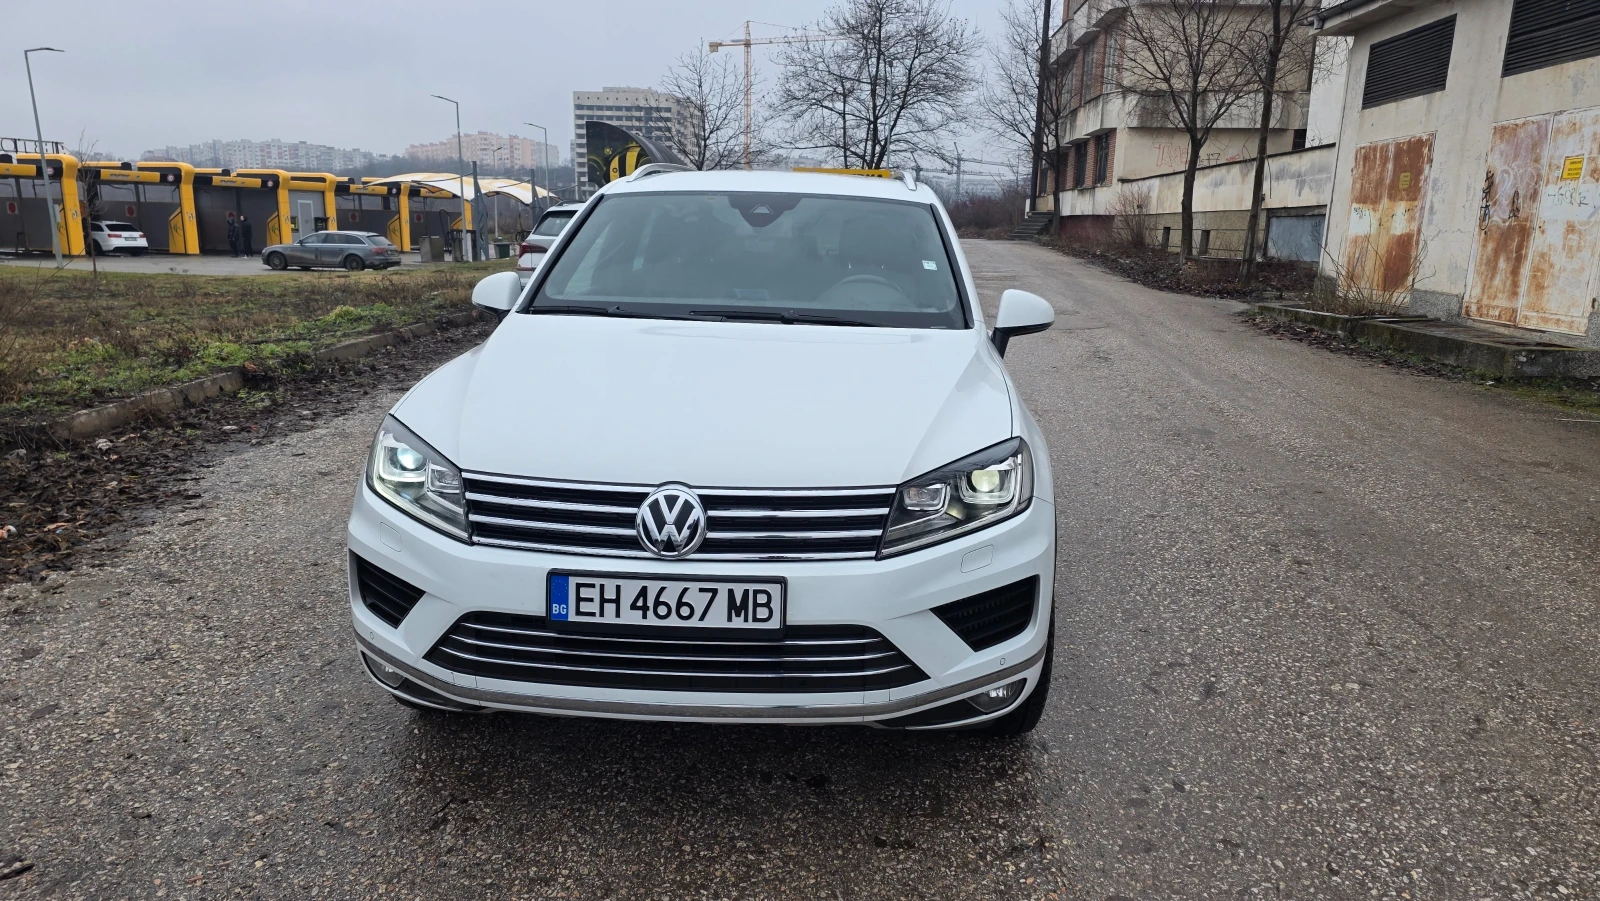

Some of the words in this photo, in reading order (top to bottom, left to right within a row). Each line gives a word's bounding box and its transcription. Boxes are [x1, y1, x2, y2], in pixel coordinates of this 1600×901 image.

[638, 488, 704, 557] VW
[552, 603, 567, 615] BG
[575, 582, 622, 619] EH
[629, 585, 719, 622] 4667
[726, 588, 774, 623] MB
